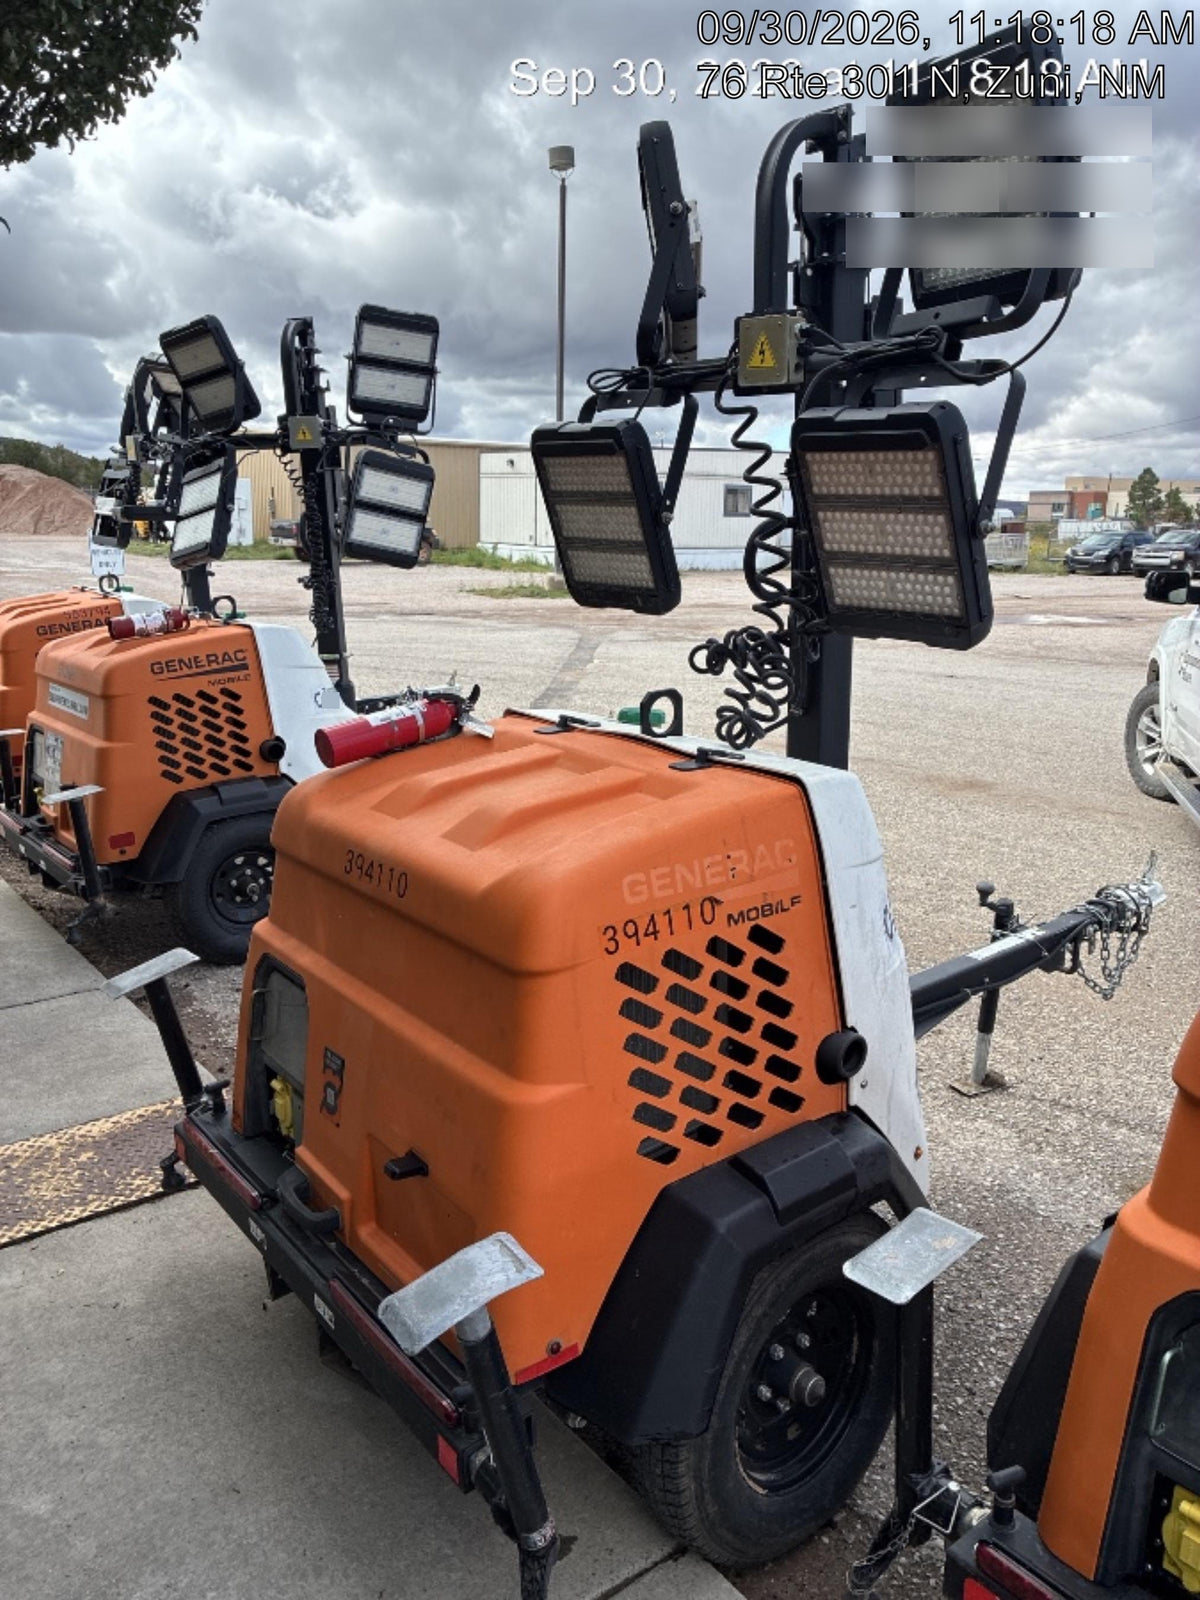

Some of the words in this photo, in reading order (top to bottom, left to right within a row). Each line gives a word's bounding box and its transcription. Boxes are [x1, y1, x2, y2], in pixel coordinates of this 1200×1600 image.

[150, 648, 247, 675] GENERAC
[344, 848, 409, 899] 394110
[621, 838, 798, 905] GENERAC
[602, 896, 720, 956] 394110
